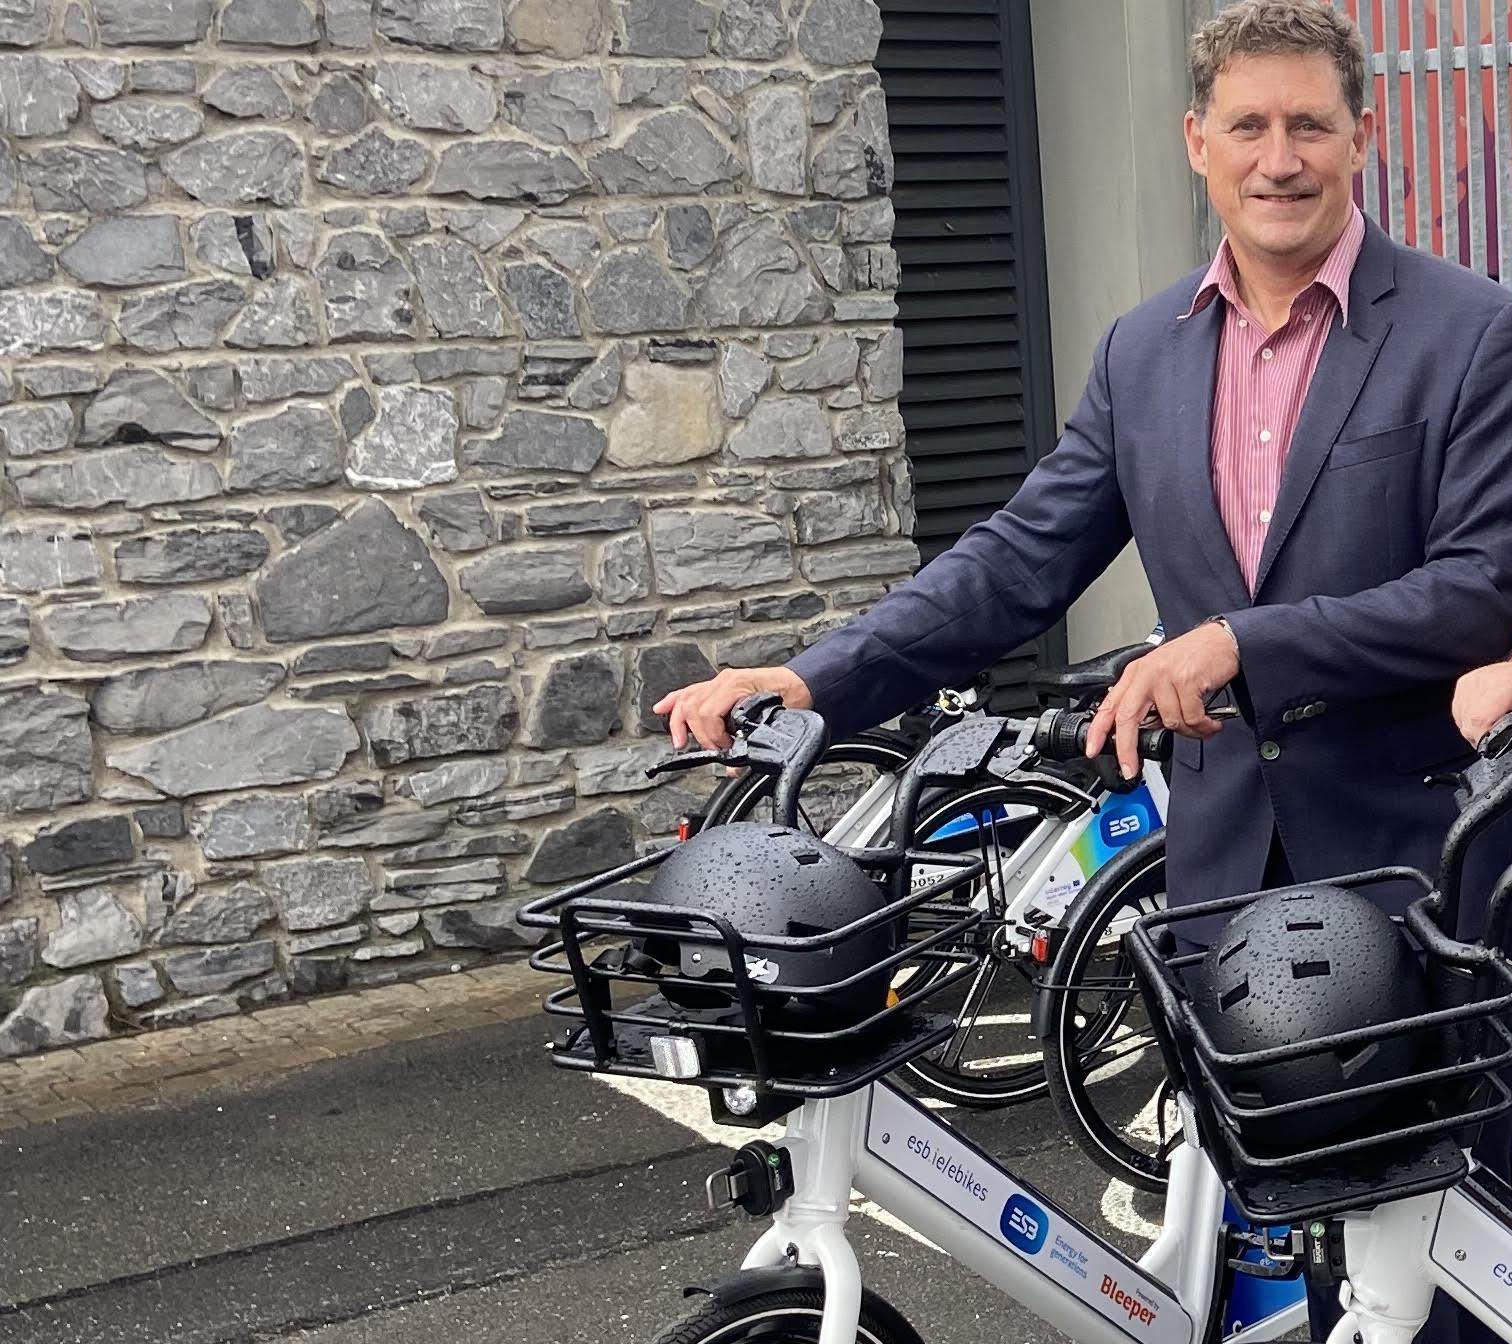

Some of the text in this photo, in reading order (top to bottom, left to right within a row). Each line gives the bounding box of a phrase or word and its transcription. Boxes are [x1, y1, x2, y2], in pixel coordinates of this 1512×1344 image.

[1109, 815, 1140, 837] ESB
[906, 1132, 989, 1202] esb.ie/ebikes
[1008, 1206, 1039, 1240] ESB
[1100, 1273, 1157, 1327] Bleeper
